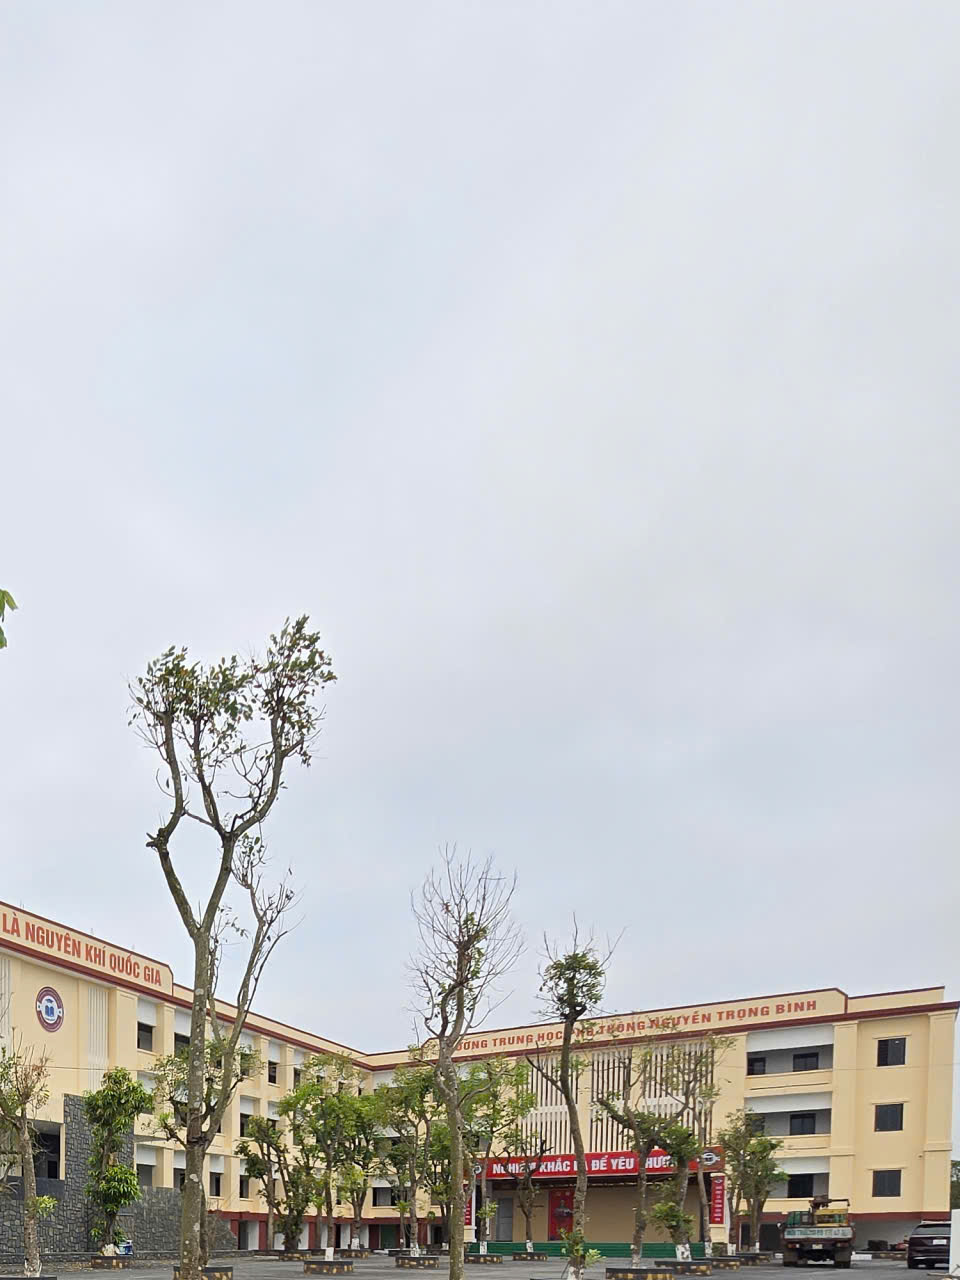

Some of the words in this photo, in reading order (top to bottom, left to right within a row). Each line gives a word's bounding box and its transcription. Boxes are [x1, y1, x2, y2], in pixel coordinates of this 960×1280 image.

[2, 912, 20, 938] LÀ
[25, 921, 81, 958] NGUYÊN
[85, 944, 106, 968] KHÍ
[109, 953, 140, 979] QUỐC
[143, 965, 162, 987] GIA
[492, 1034, 533, 1048] TRUNG
[537, 1030, 563, 1045] HỌC
[718, 1005, 769, 1022] TRỌNG
[776, 1000, 817, 1014] BÌNH
[591, 1155, 609, 1171] ĐỂ
[611, 1156, 634, 1170] YÊU
